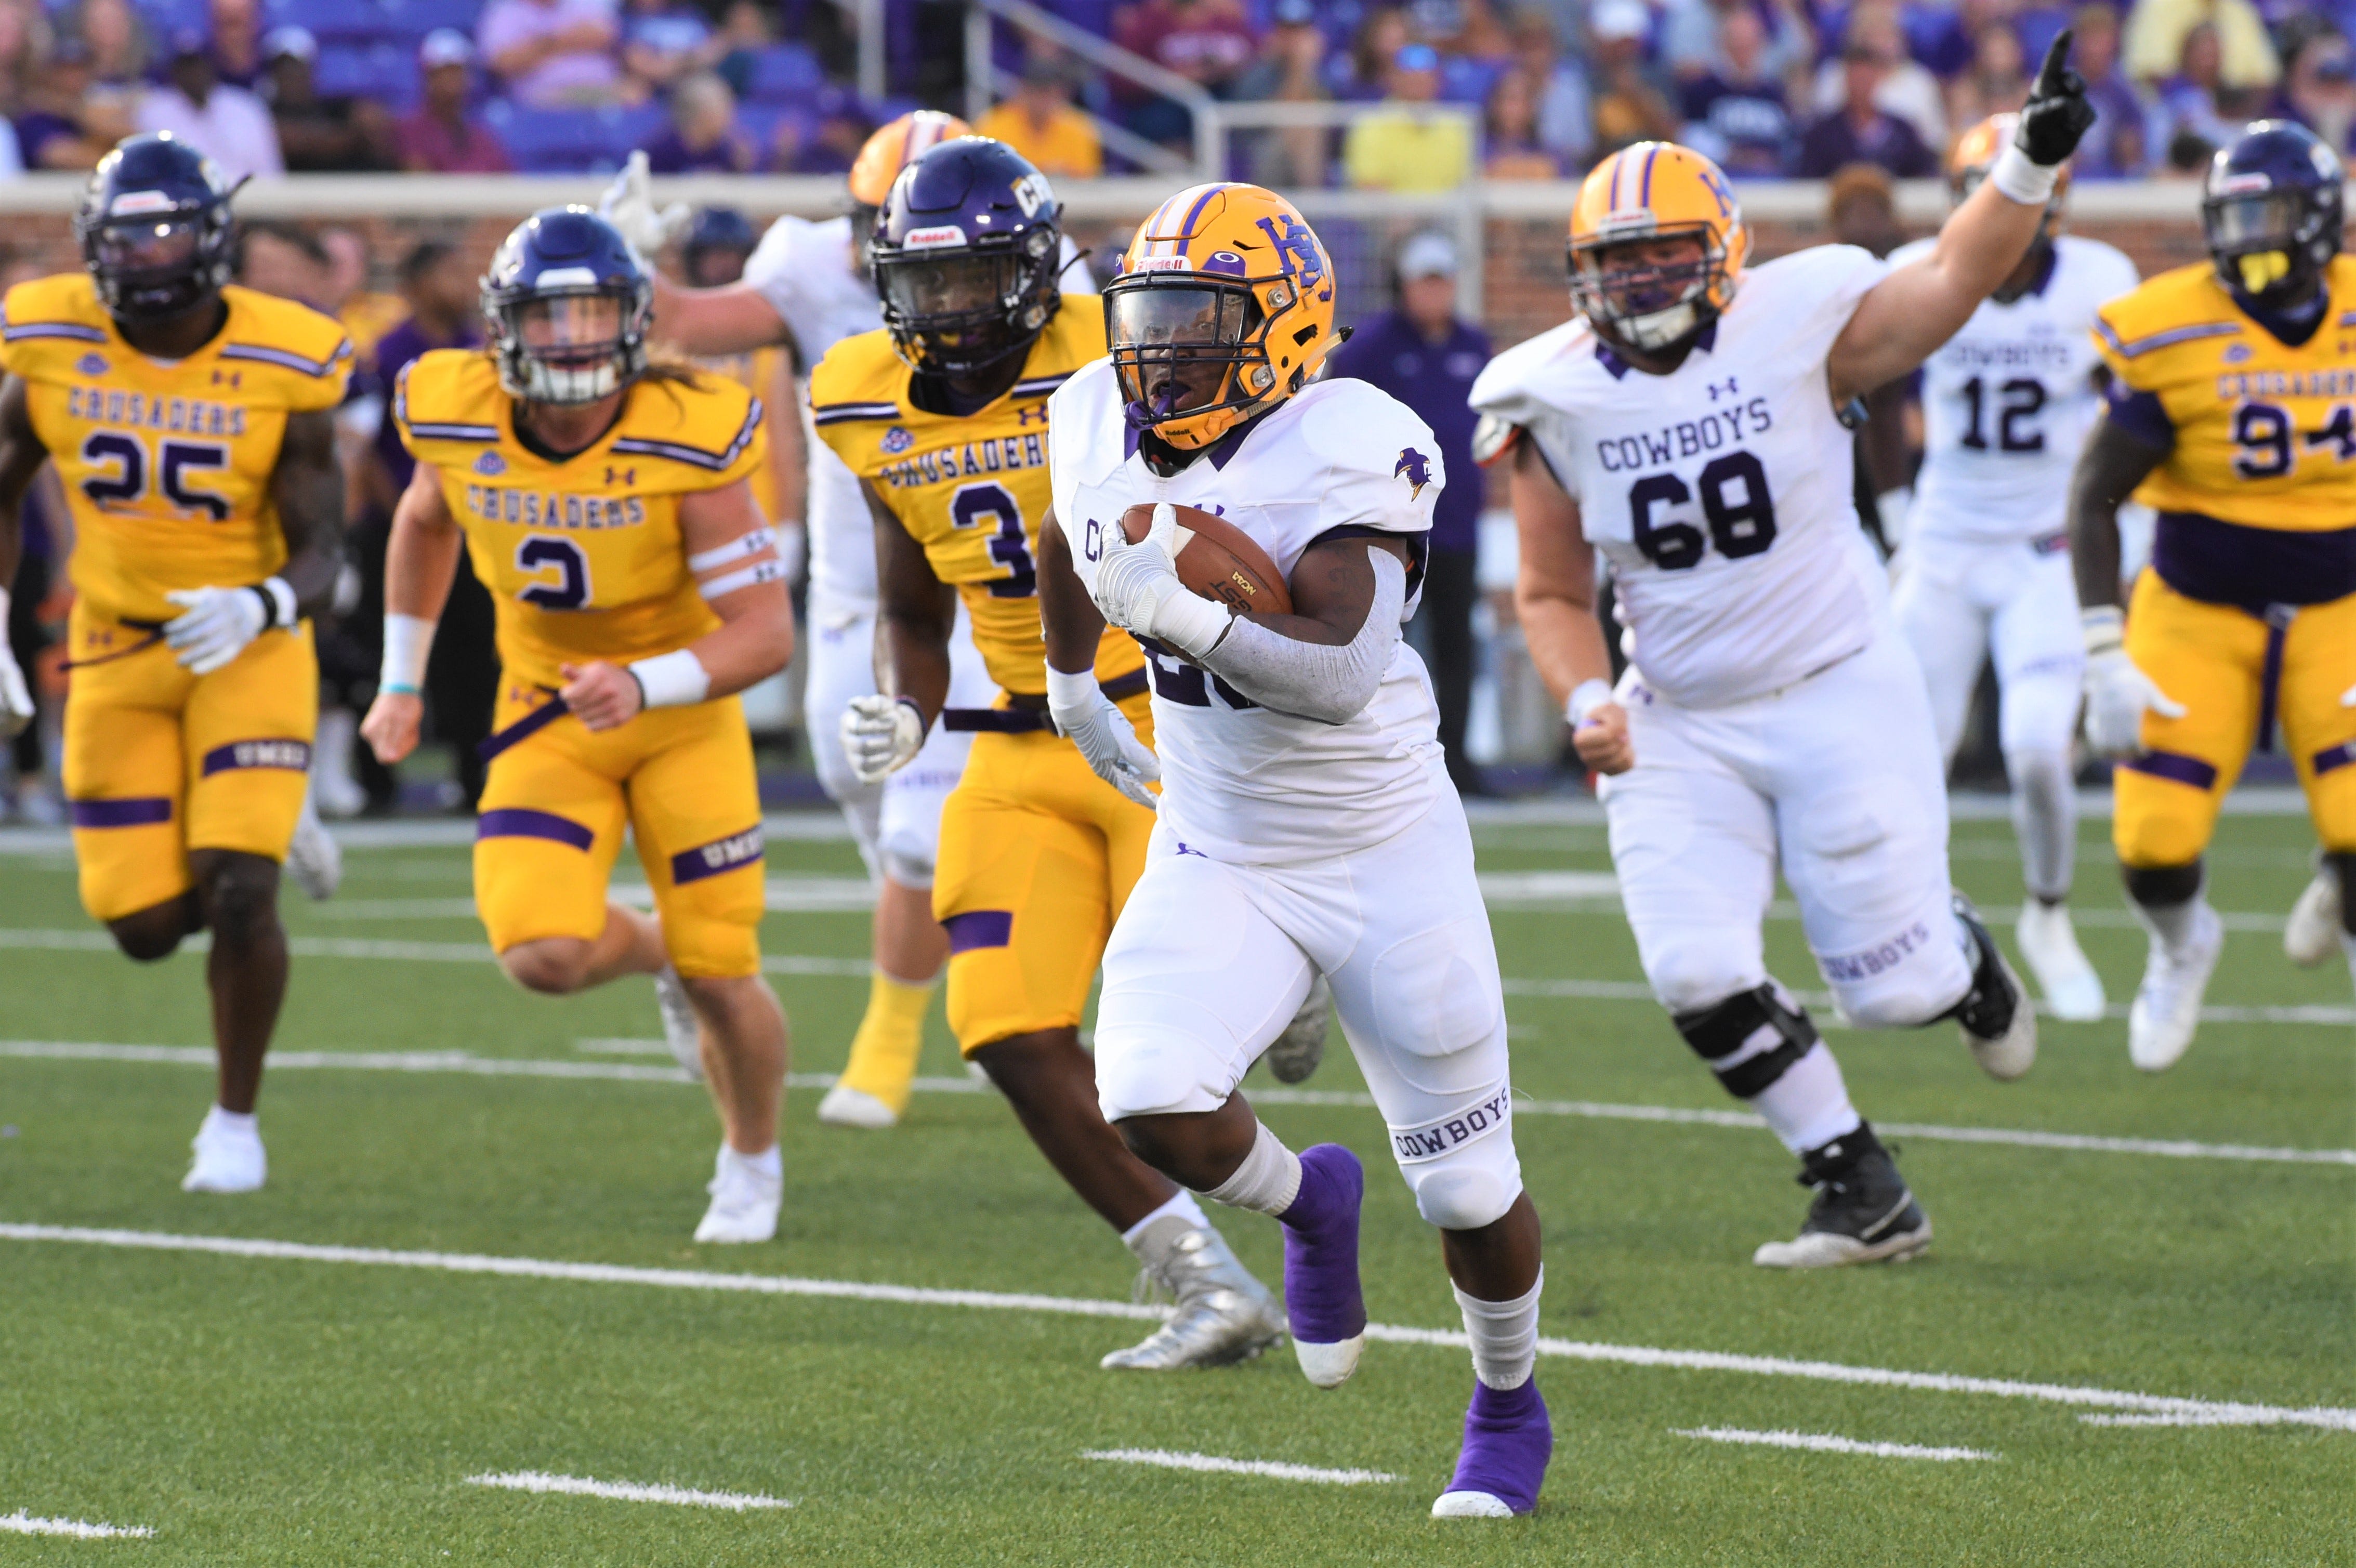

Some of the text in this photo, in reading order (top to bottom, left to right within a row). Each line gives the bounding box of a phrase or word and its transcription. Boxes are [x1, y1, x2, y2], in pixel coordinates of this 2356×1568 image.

[70, 386, 245, 437] CRUSADERS
[1598, 397, 1771, 471] COWBOYS
[1960, 374, 2046, 451] 12
[2231, 398, 2356, 480] 94
[82, 427, 233, 522] 25
[880, 430, 1049, 488] CRUSADER
[467, 484, 646, 531] CRUSADERS
[949, 479, 1038, 598] 3
[1628, 450, 1777, 570] 68
[515, 533, 594, 611] 2
[1232, 571, 1257, 596] NCAA
[1395, 1087, 1508, 1157] COWBOYS
